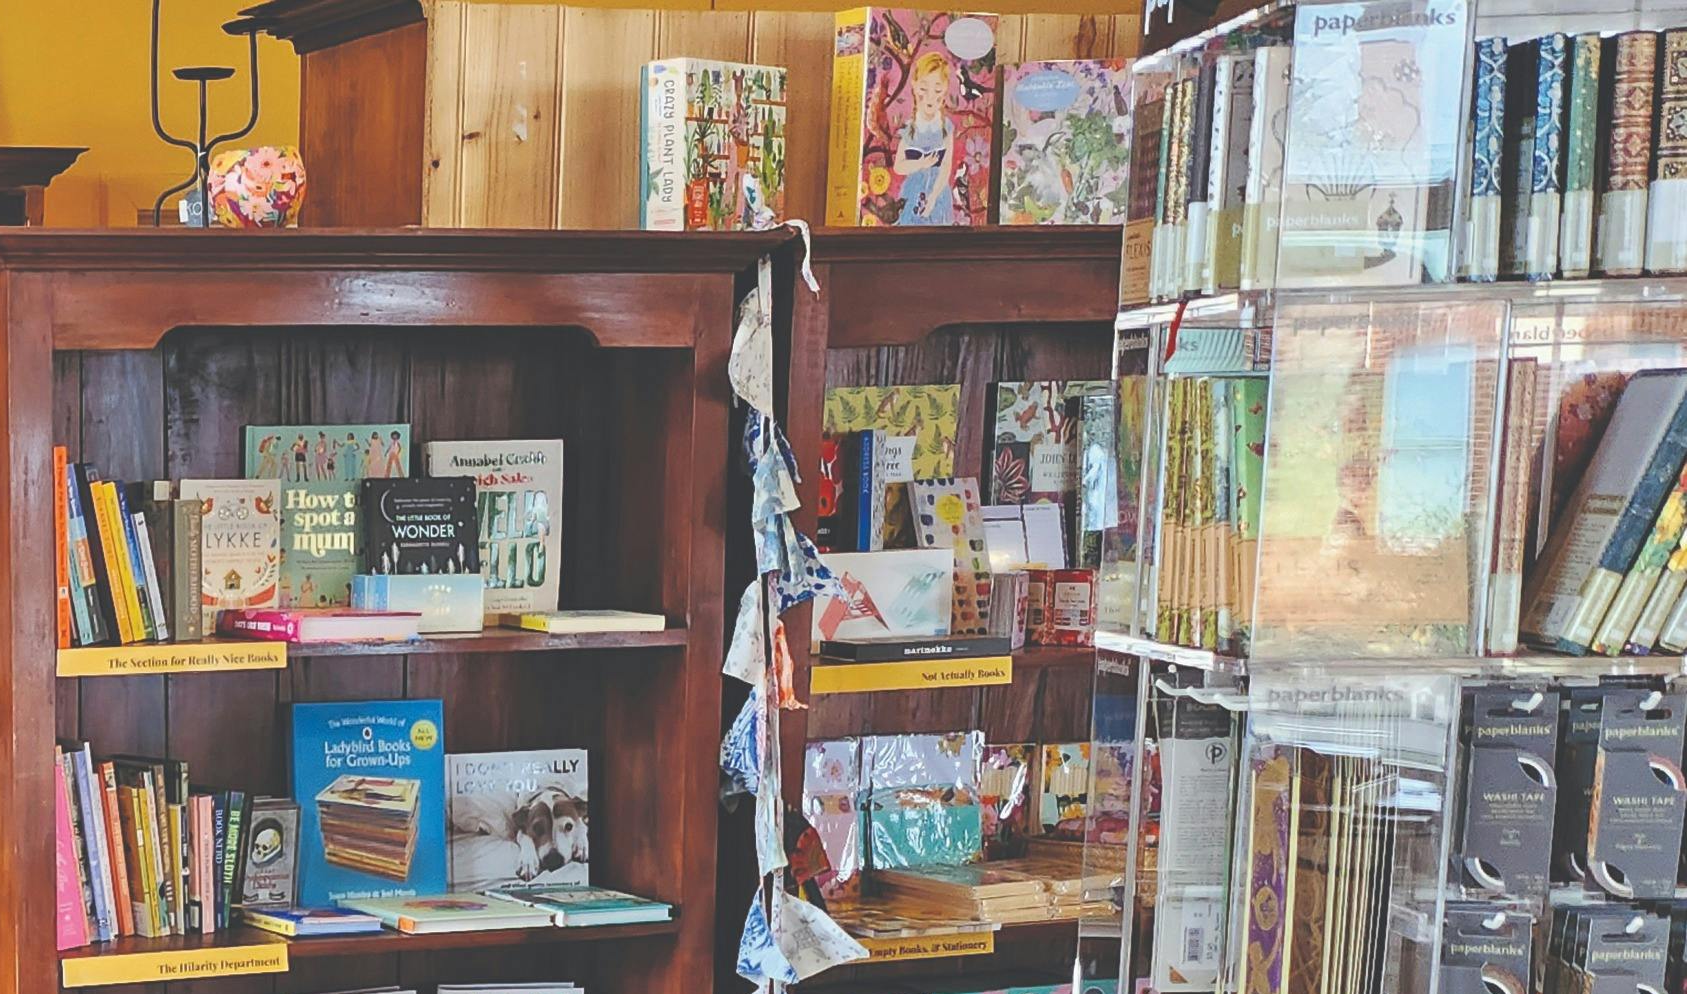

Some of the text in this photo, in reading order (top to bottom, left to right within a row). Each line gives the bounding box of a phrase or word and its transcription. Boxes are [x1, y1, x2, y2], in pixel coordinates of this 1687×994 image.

[1314, 8, 1456, 36] paperblanks
[662, 80, 674, 202] CRAZY PLANT LADY
[450, 454, 503, 466] Annabel
[285, 489, 354, 509] How t
[294, 512, 354, 528] spot a
[392, 525, 455, 538] WONDER
[206, 532, 261, 549] LYKKE
[292, 533, 354, 557] mum
[108, 653, 278, 669] The Section for Really Nice Books
[922, 668, 1006, 682] Not Actually Books
[1268, 686, 1404, 706] paperblanks
[1478, 725, 1551, 737] paperblanks
[1605, 728, 1679, 738] paperblanks
[325, 740, 411, 754] Ladybird Books
[326, 754, 411, 768] for Grown-Ups
[1484, 793, 1545, 801] WASHI TAPE
[1613, 797, 1674, 805] WASHI TAPE
[223, 811, 240, 884] BE SLOTH
[943, 941, 986, 951] Stationery
[1451, 944, 1525, 955] paperblanks
[1592, 950, 1661, 961] paperblanks
[159, 958, 280, 974] The Hilarity Department
